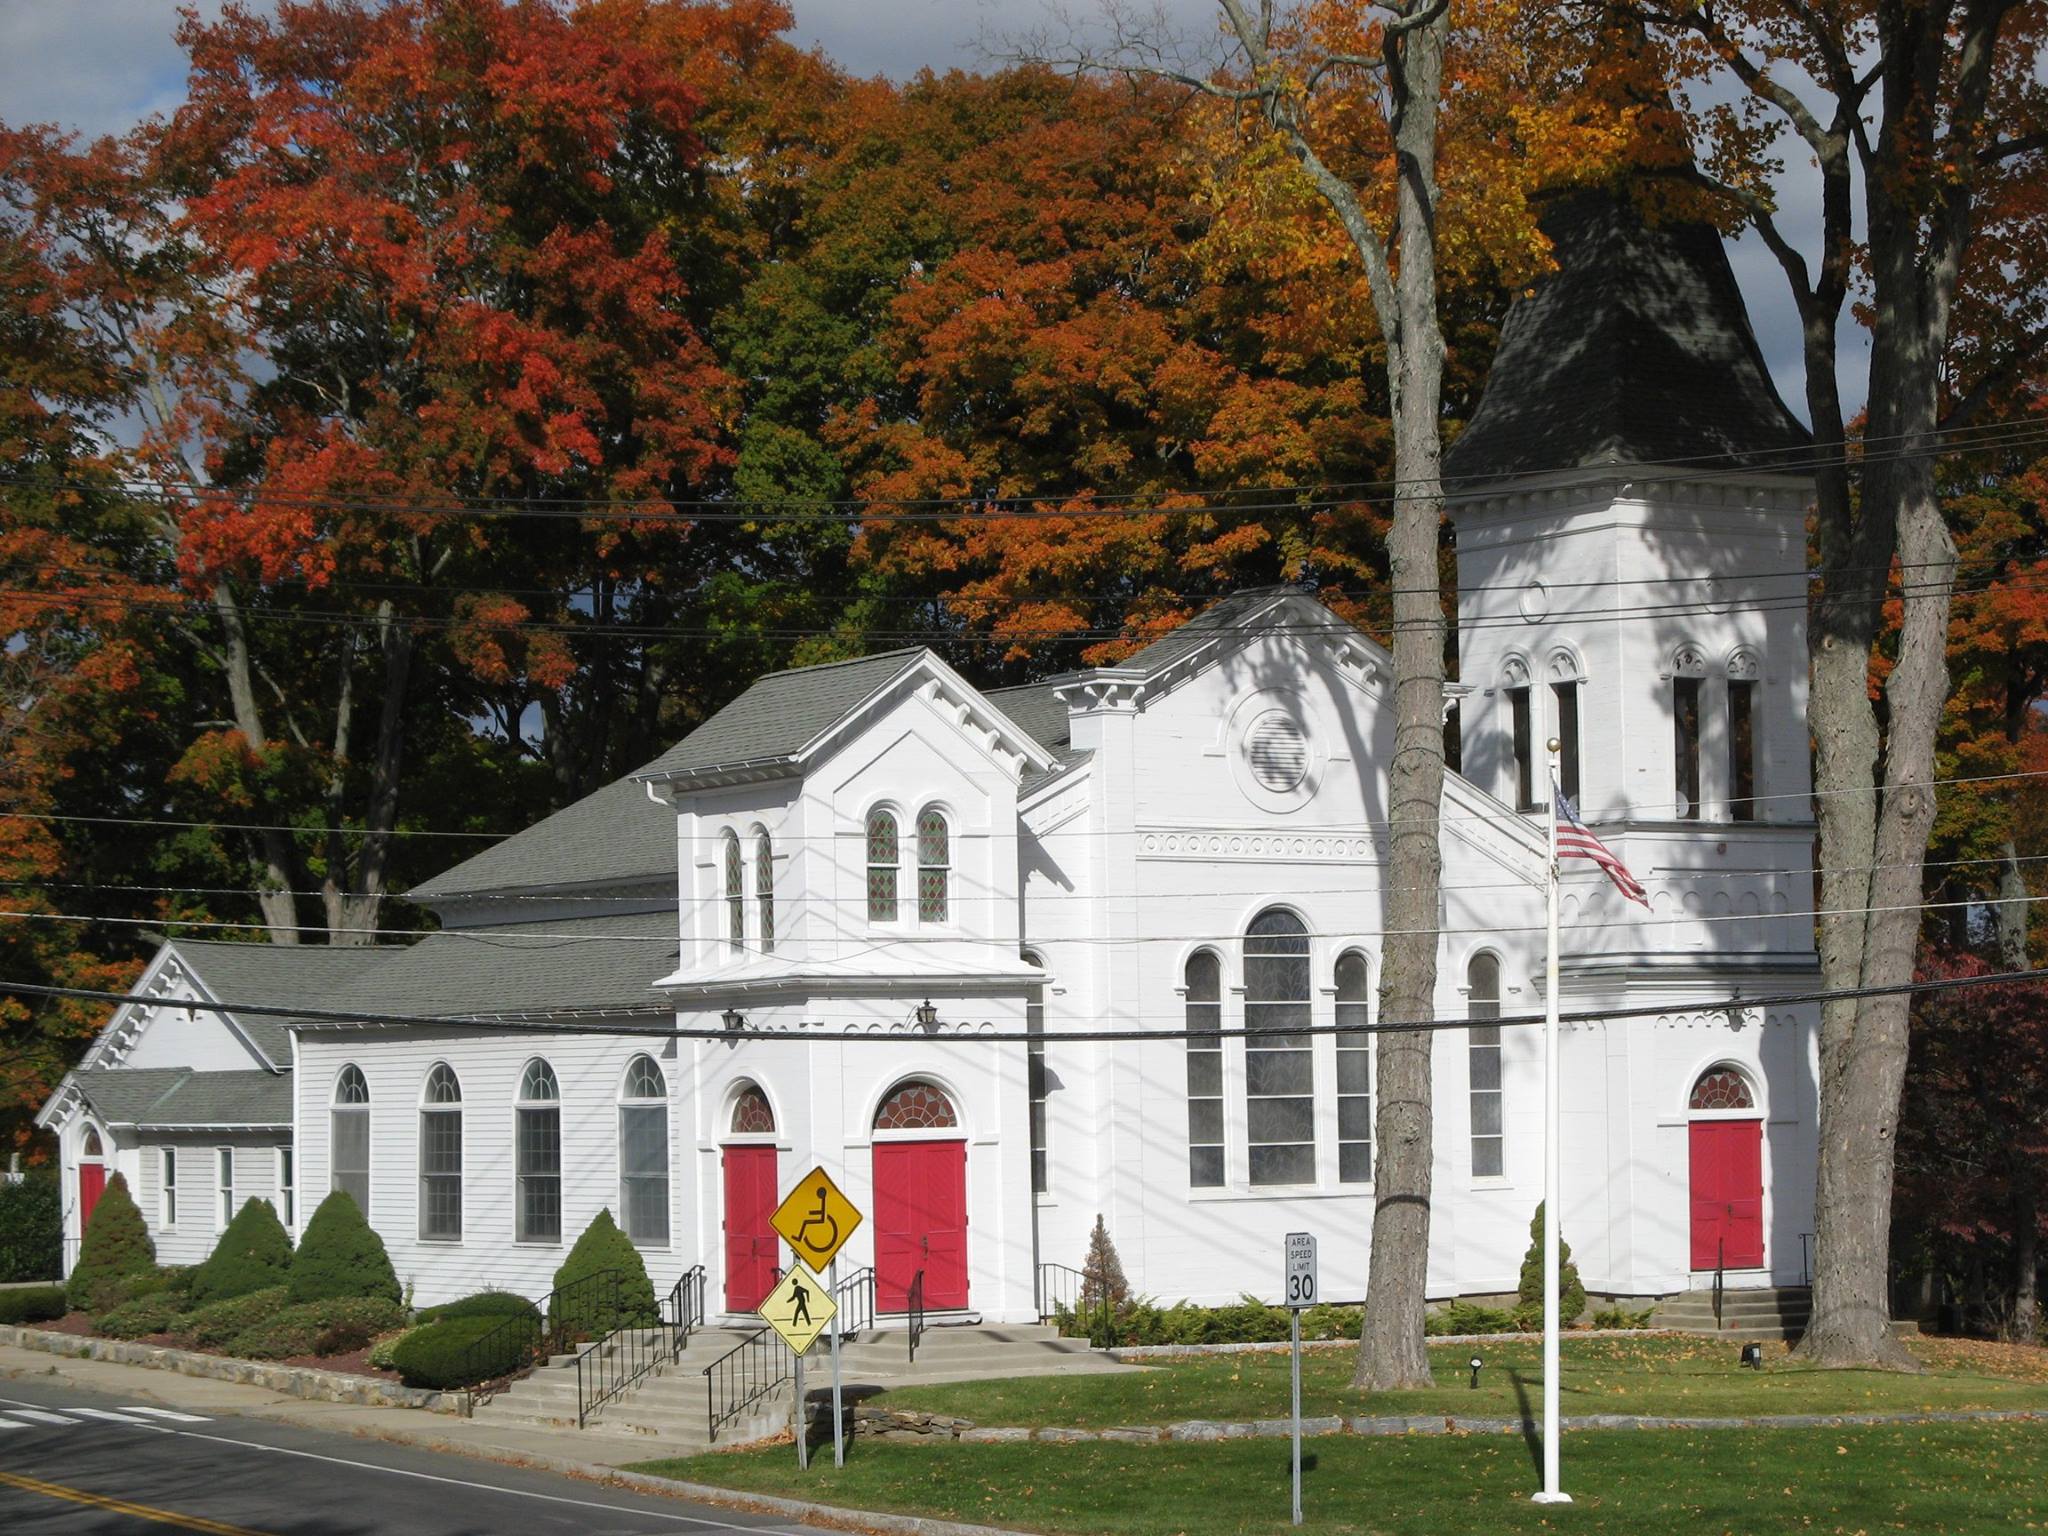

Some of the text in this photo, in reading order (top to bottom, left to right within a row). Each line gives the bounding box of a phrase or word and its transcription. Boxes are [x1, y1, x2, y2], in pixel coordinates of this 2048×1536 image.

[1292, 1238, 1310, 1247] AREA
[1291, 1250, 1312, 1259] SPEED
[1293, 1263, 1310, 1271] LIMIT
[1290, 1274, 1313, 1301] 30
